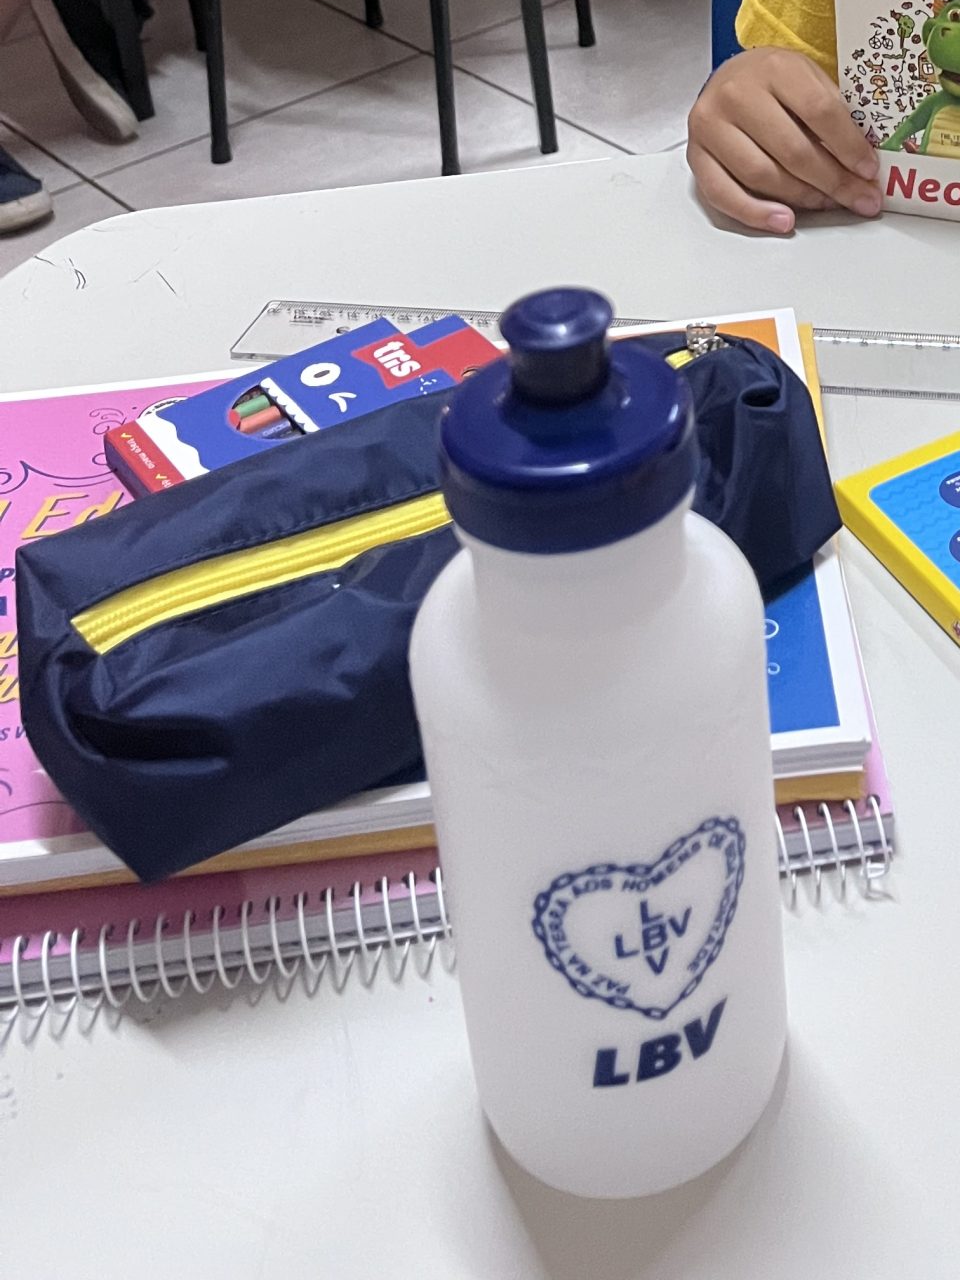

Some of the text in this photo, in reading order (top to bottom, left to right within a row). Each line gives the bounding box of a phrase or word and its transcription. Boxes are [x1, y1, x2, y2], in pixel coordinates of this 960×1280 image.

[127, 437, 156, 469] traço macio
[621, 841, 702, 892] HOMENS
[571, 878, 613, 899] AOS
[549, 899, 571, 952] TERRA
[568, 952, 592, 977] NA
[591, 973, 631, 996] PAZ
[593, 995, 728, 1088] LBV
